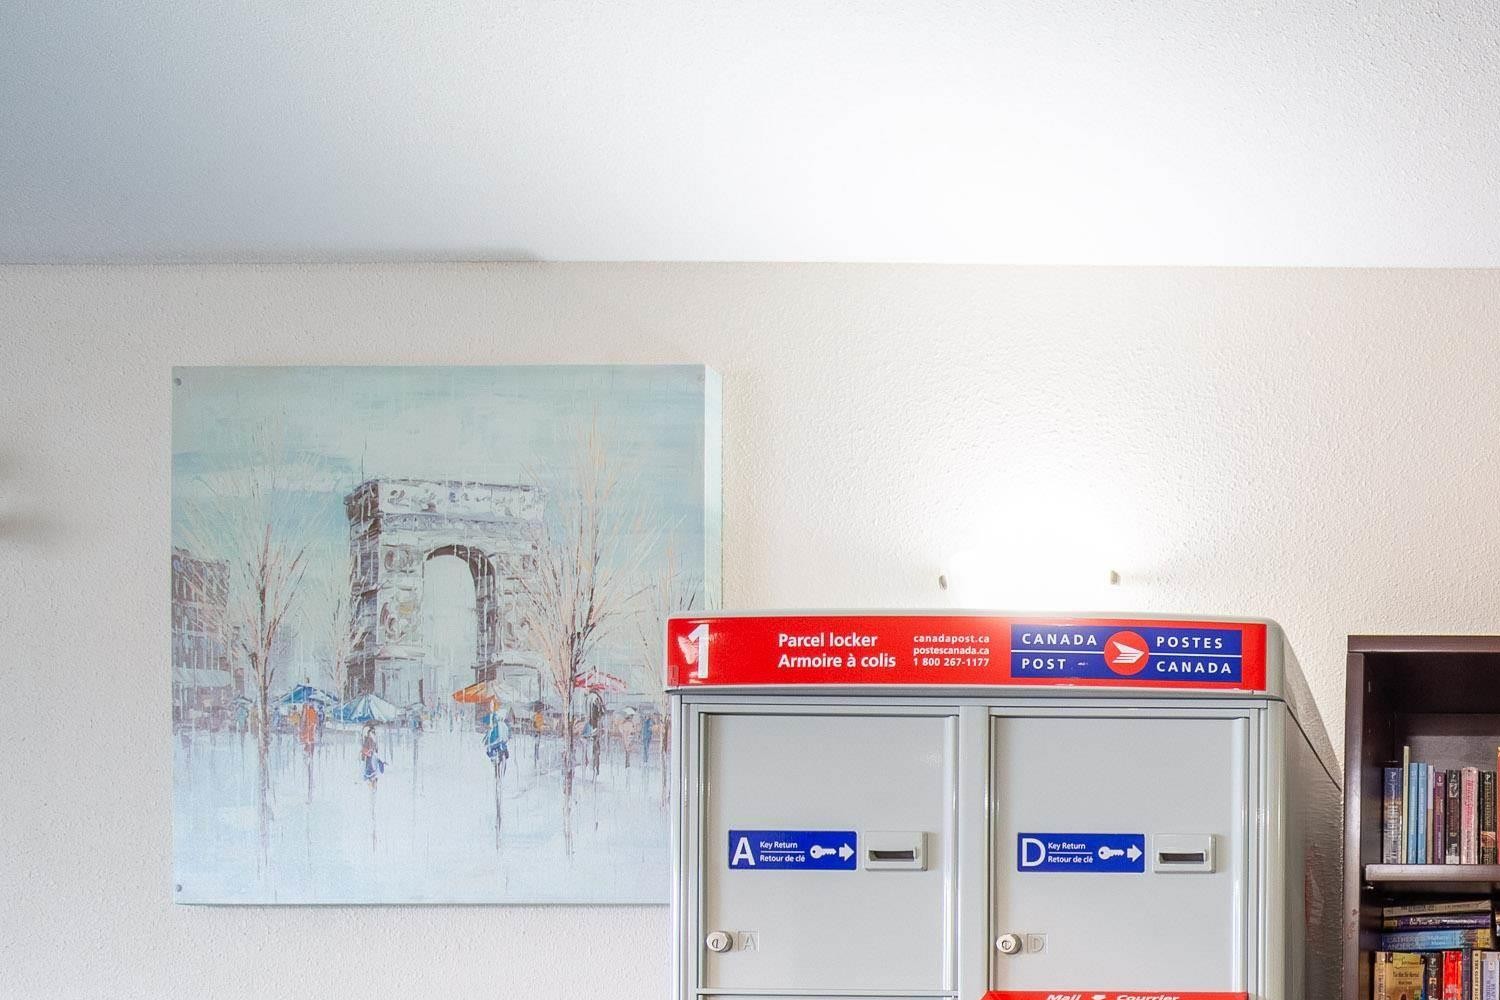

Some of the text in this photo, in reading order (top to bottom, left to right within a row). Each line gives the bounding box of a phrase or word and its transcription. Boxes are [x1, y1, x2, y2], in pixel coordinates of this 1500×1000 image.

[779, 632, 878, 647] Parcel locker
[913, 634, 990, 644] canadapost.ca
[1021, 633, 1097, 646] CANADA
[1156, 636, 1223, 649] POSTES
[913, 645, 990, 656] postescanada.ca
[777, 653, 896, 668] Armoire à colis
[913, 657, 990, 667] 1 800 267-1177
[1021, 658, 1067, 670] POST
[1156, 661, 1232, 674] CANADA
[731, 837, 756, 865] A
[760, 841, 798, 850] Key Return
[1048, 842, 1085, 851] Key Return
[1022, 838, 1046, 867] D
